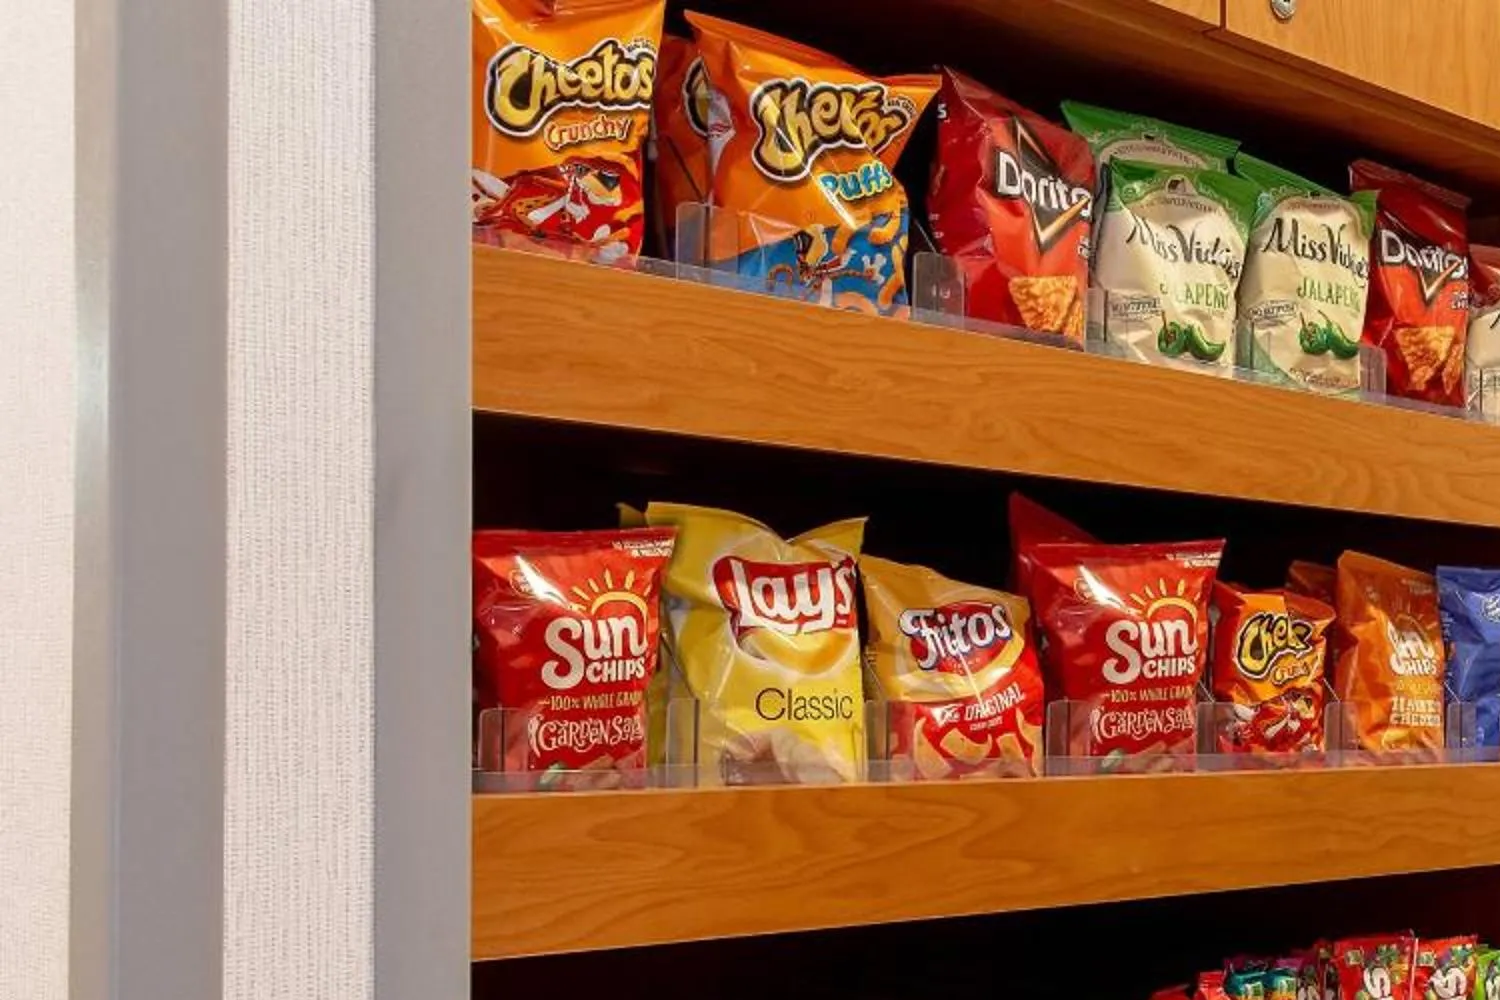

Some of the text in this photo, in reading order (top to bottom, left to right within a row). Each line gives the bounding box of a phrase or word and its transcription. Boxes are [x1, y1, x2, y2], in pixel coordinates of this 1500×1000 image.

[544, 115, 632, 150] Crunchy
[998, 152, 1092, 218] Dorito
[1261, 217, 1327, 261] Miss
[541, 614, 650, 690] Sun
[900, 604, 1011, 669] Fritos
[1102, 619, 1199, 685] Sun
[586, 656, 645, 684] CHIPS
[1141, 655, 1196, 678] CHIPS
[756, 687, 853, 721] Classic
